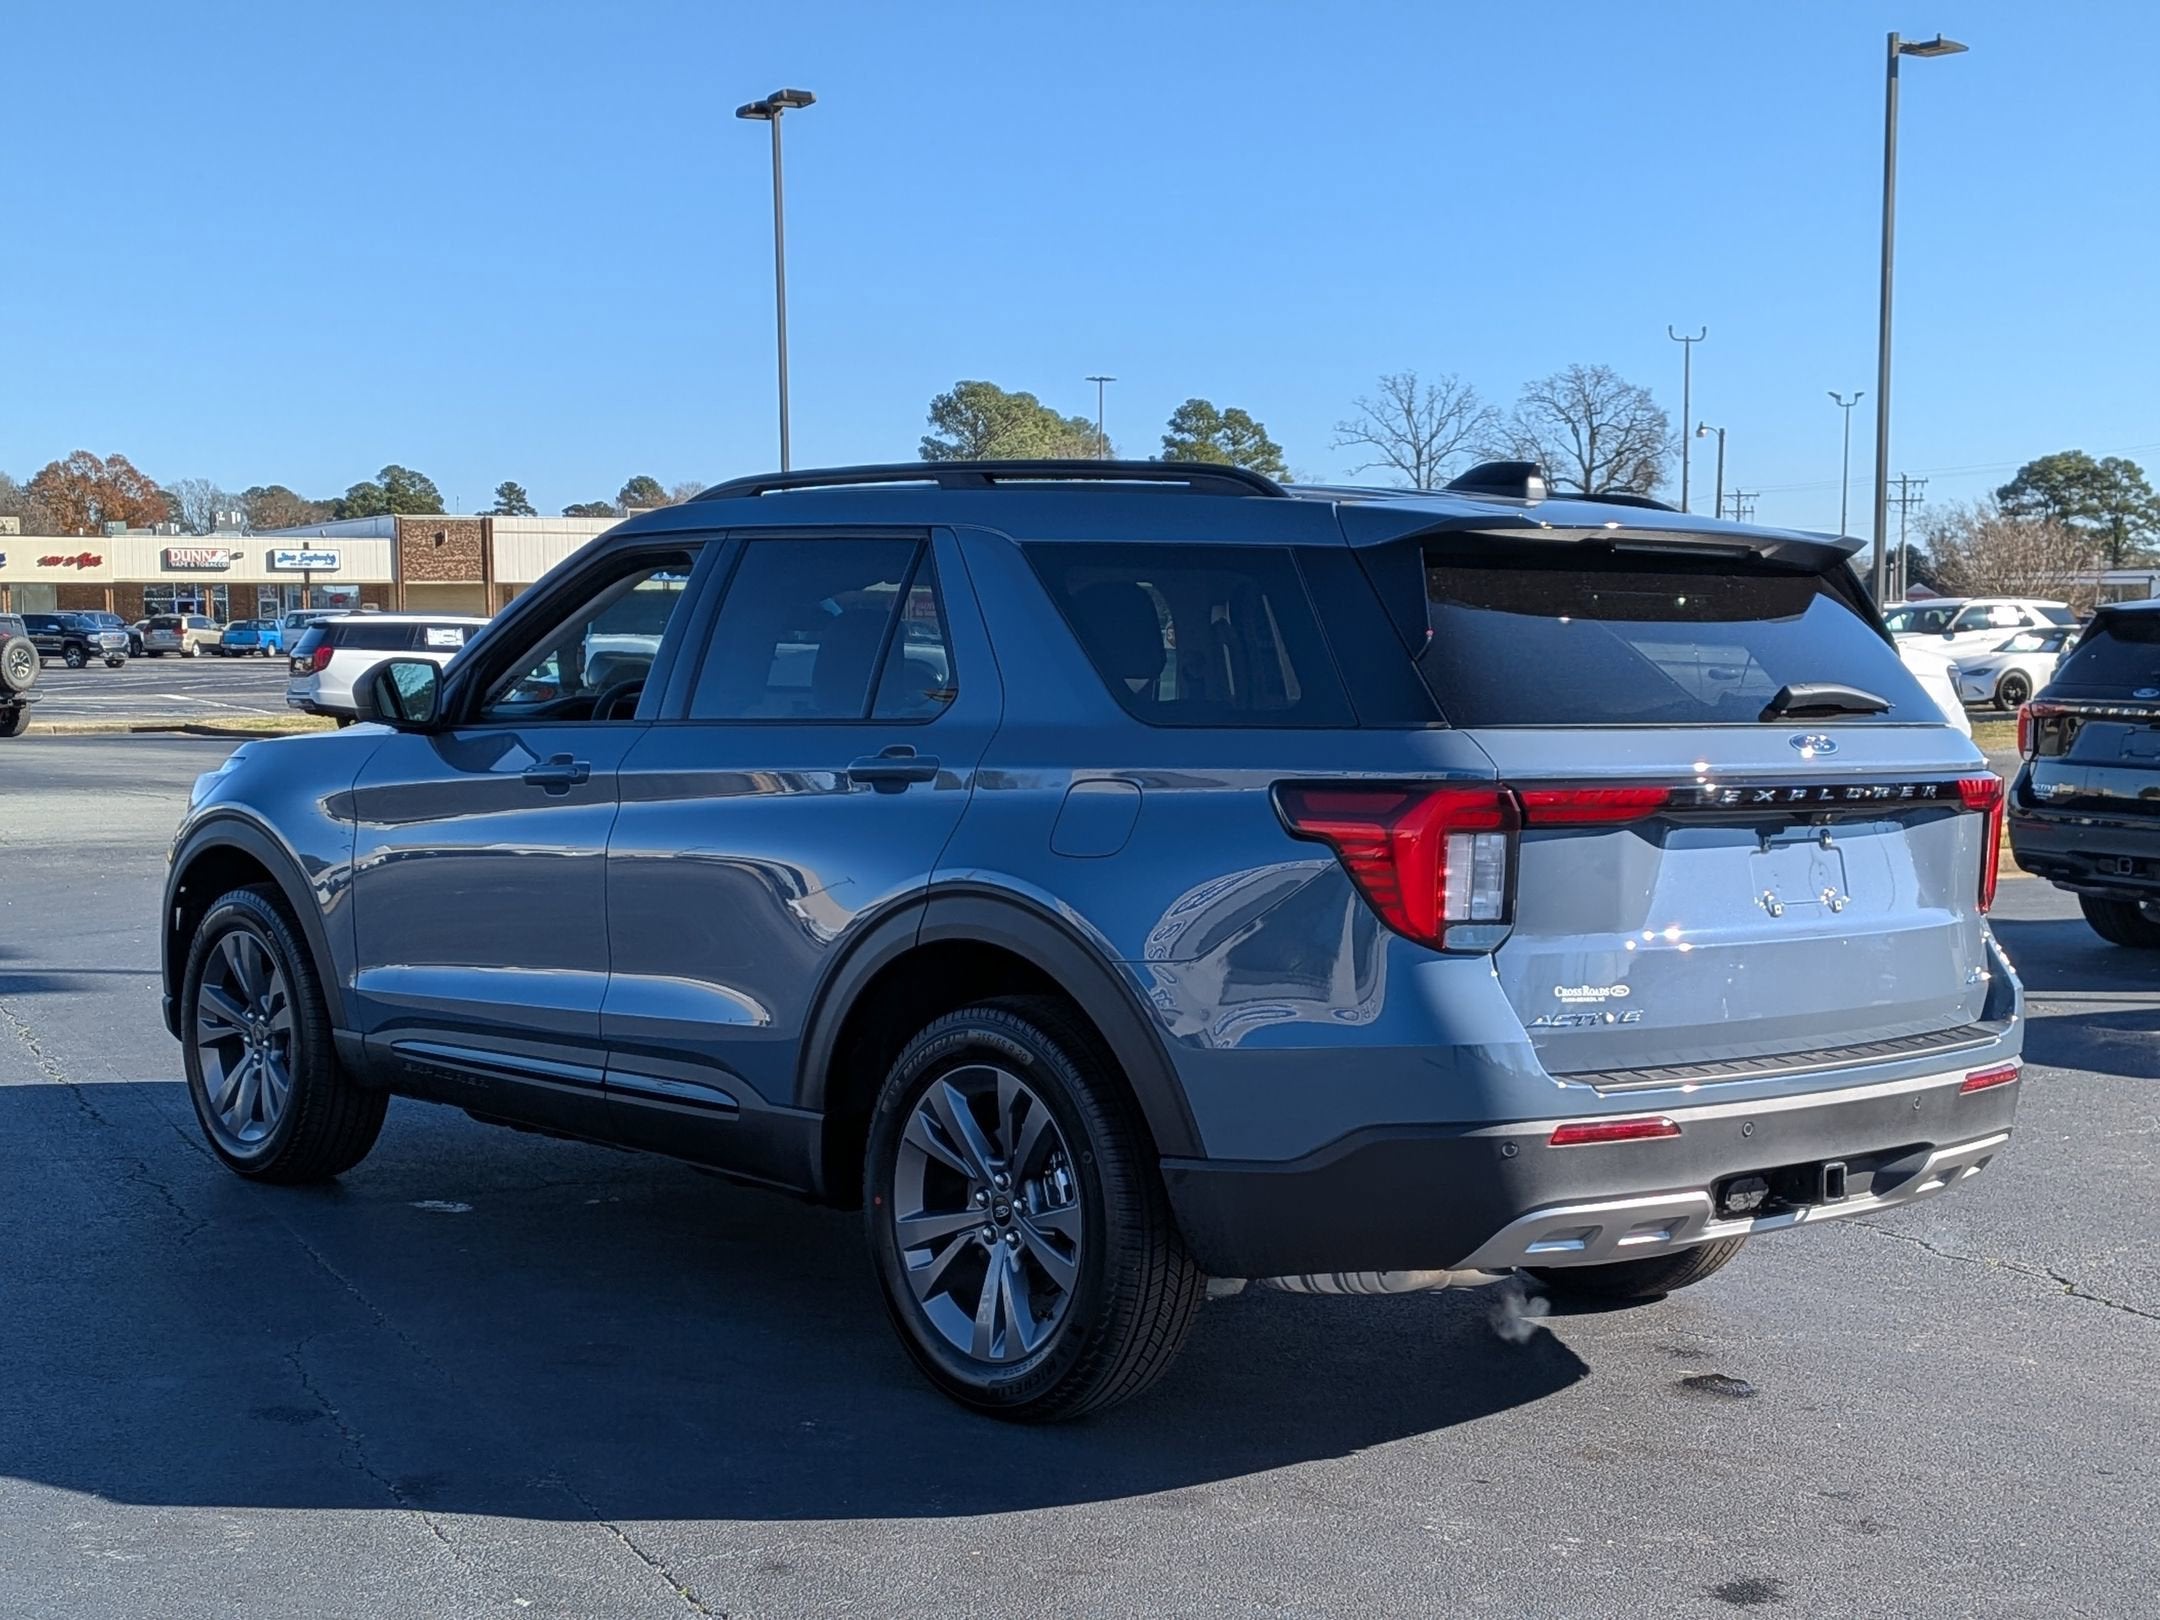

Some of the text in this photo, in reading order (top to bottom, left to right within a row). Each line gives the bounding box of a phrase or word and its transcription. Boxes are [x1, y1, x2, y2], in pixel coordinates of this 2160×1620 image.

[170, 549, 212, 562] DUNN
[1720, 784, 1938, 803] EXPLORER
[1526, 1009, 1644, 1028] ACTIVE
